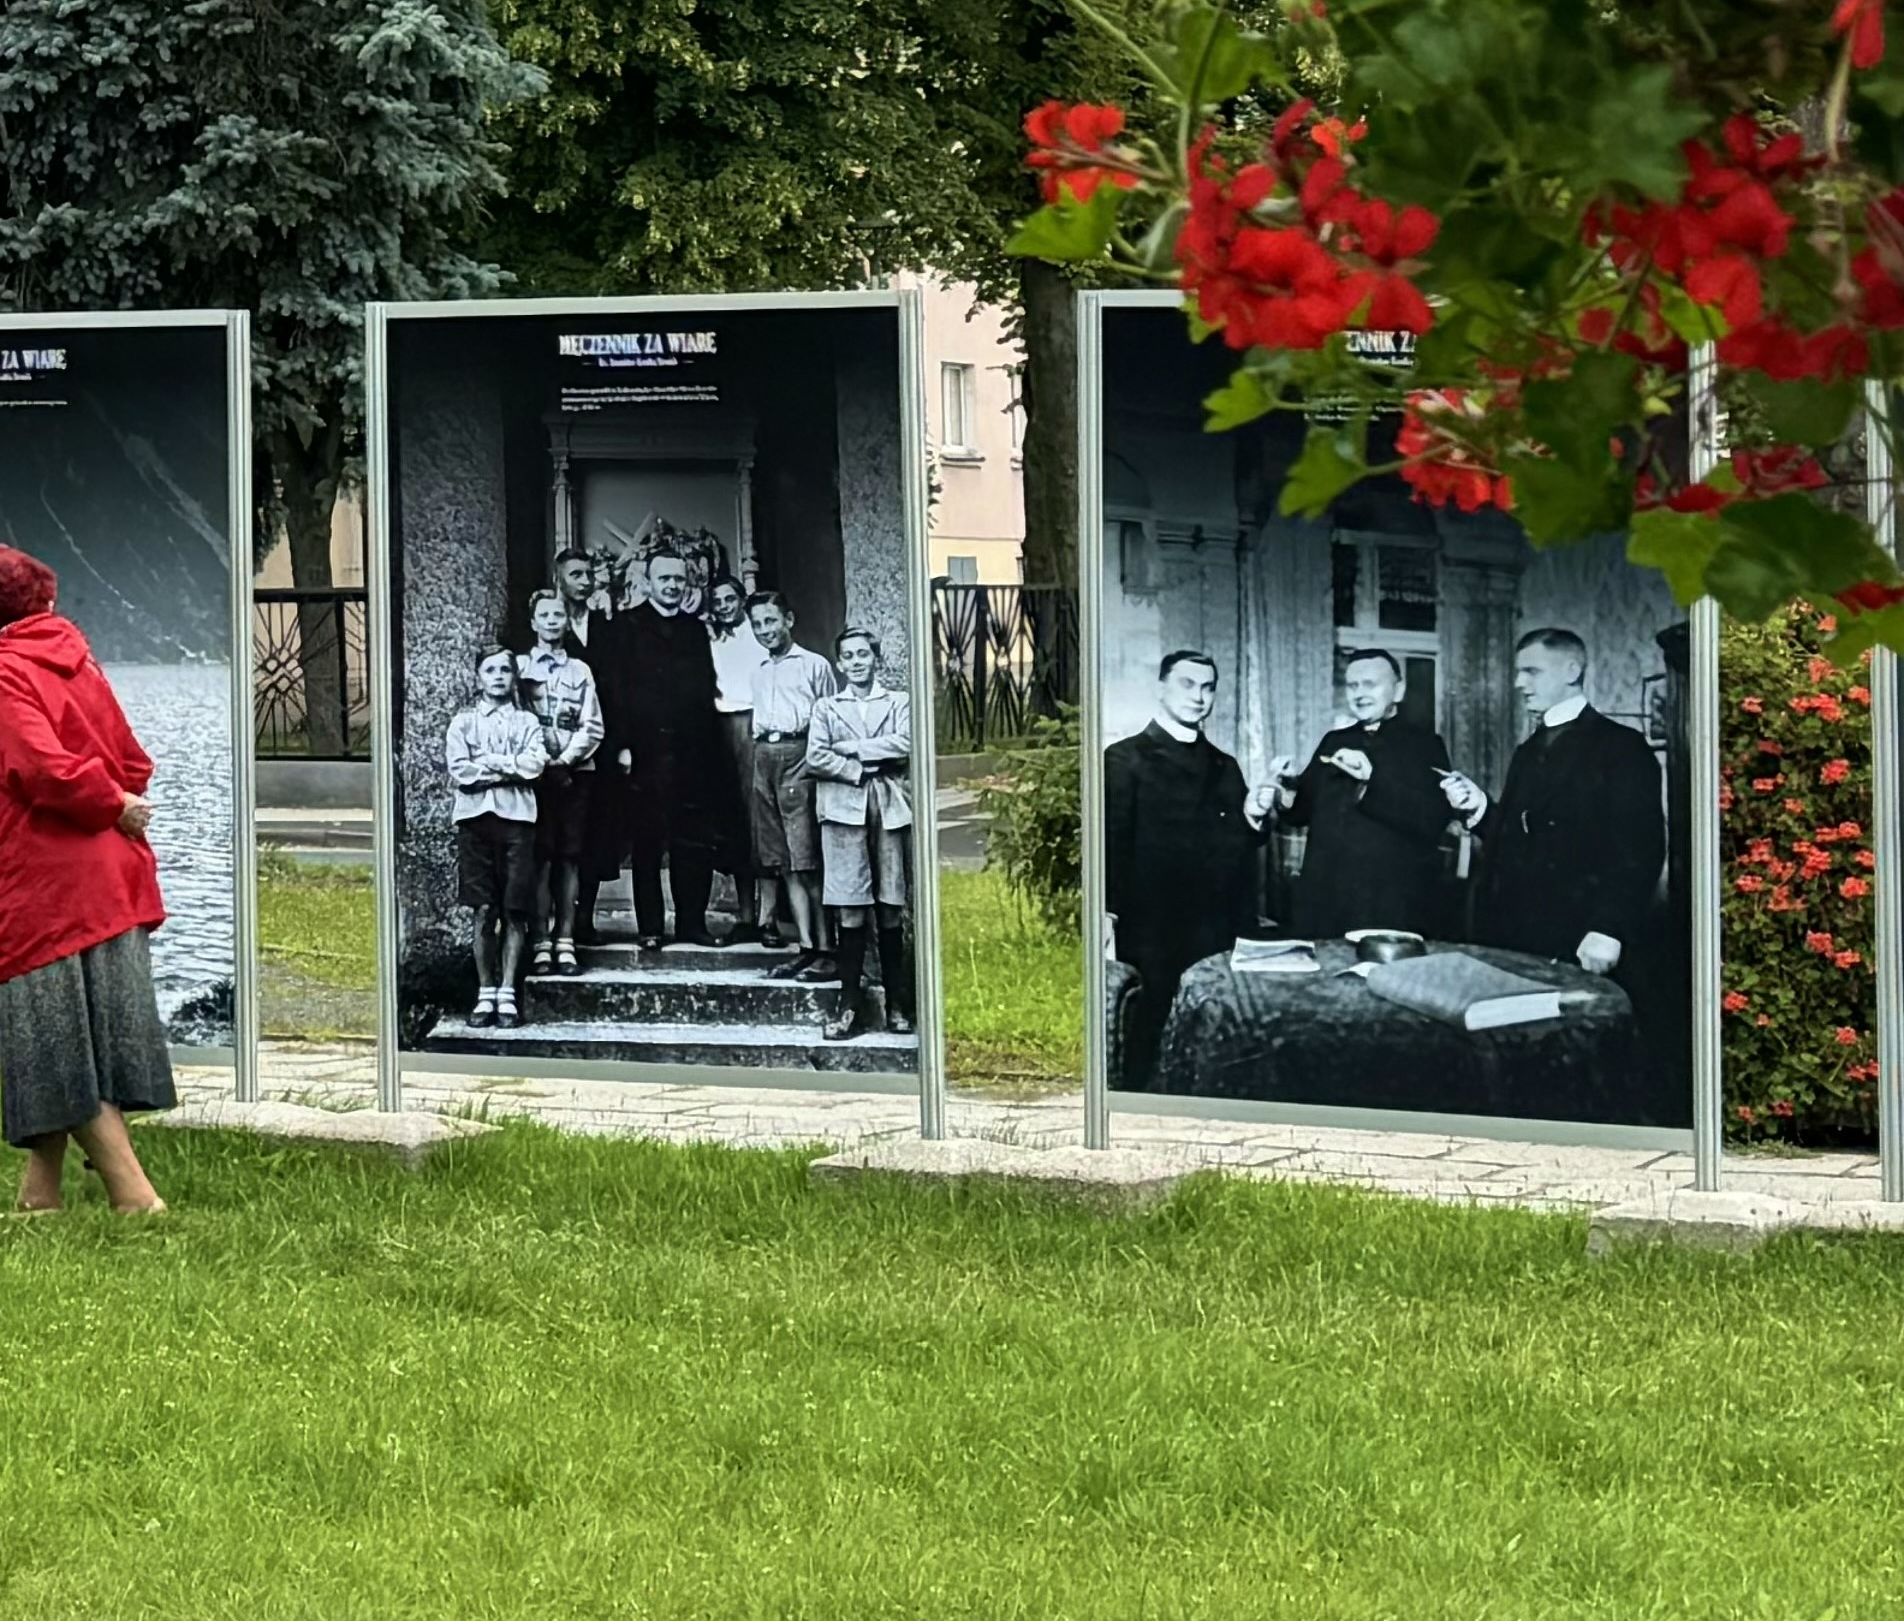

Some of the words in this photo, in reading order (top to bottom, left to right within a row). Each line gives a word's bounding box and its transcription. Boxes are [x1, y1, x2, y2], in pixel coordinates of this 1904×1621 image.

[644, 333, 664, 354] ZA
[1344, 330, 1396, 352] ENNIK
[1, 350, 19, 369] ZA
